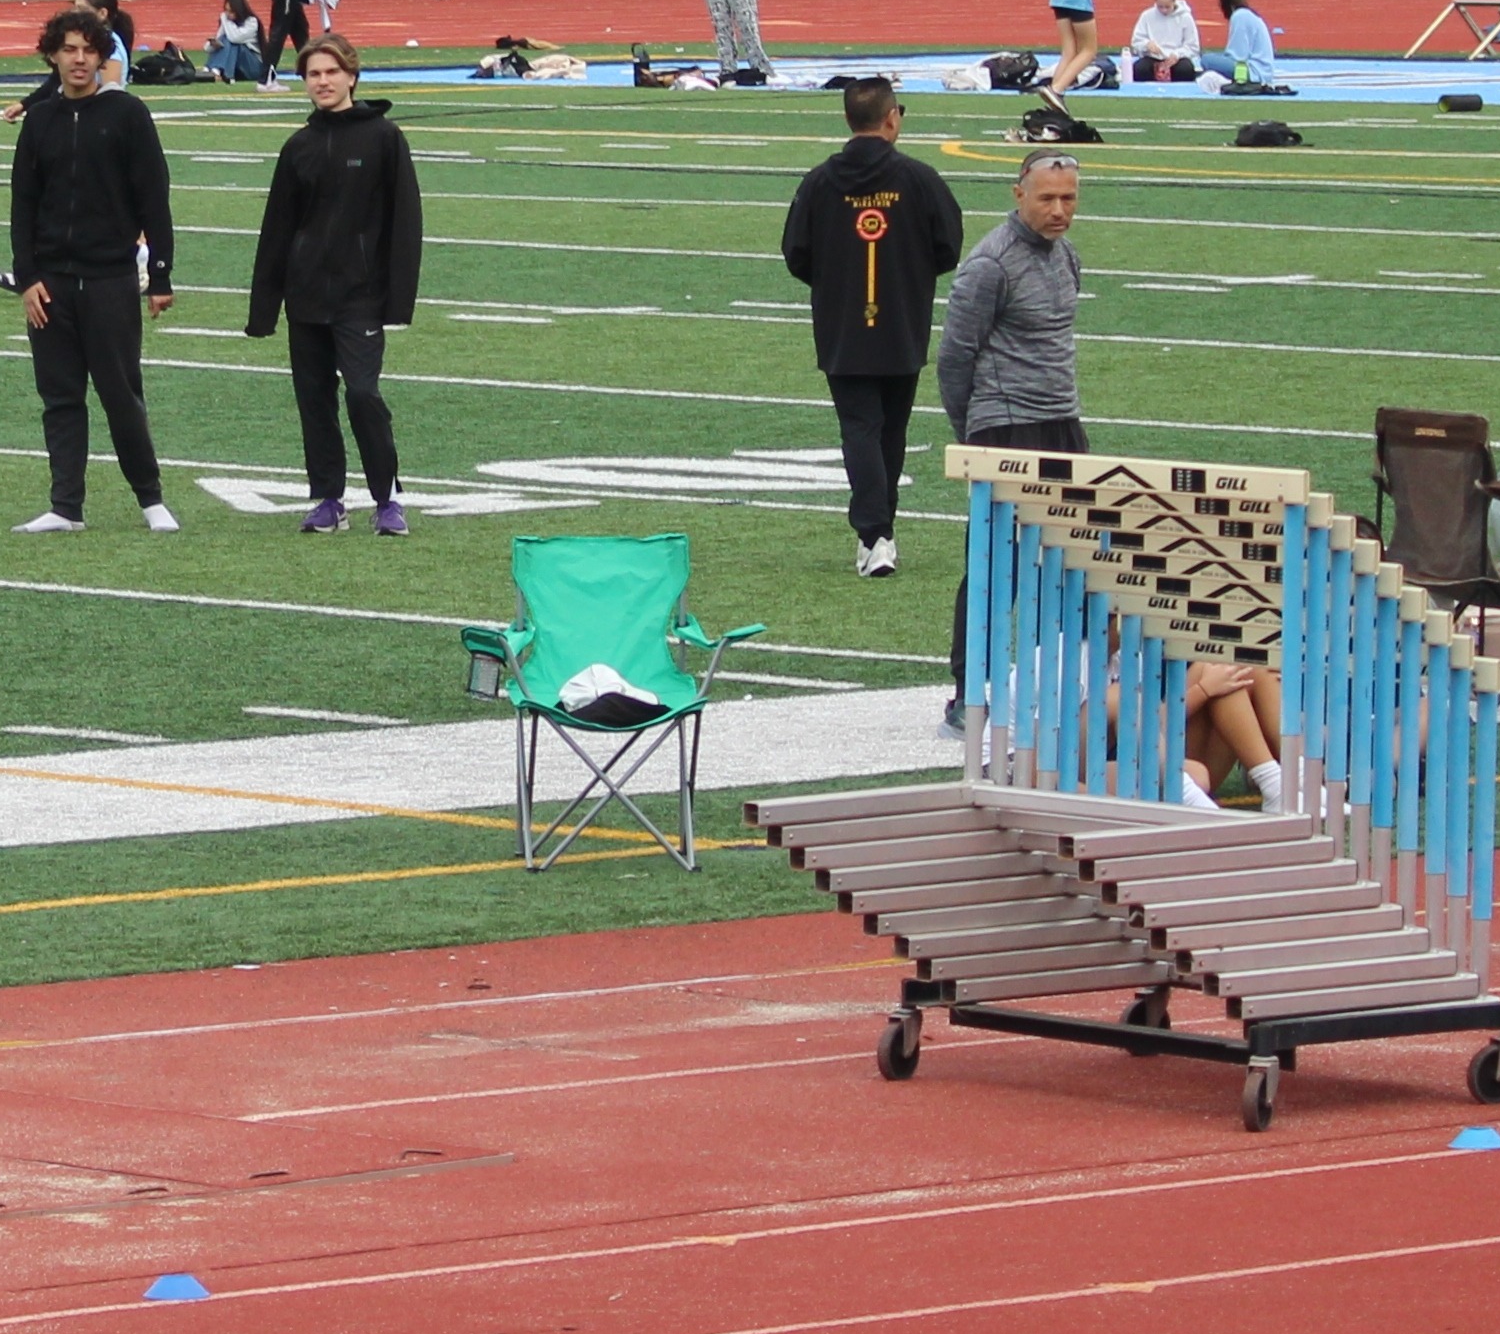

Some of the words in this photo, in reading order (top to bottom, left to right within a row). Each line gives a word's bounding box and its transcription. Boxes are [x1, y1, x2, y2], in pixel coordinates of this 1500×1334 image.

[999, 459, 1029, 474] GILL
[1021, 484, 1052, 495] GILL
[1216, 477, 1248, 491] GILL
[1048, 506, 1078, 518] GILL
[1239, 501, 1271, 514] GILL
[1070, 528, 1100, 540] GILL
[1092, 551, 1123, 563] GILL
[1116, 573, 1147, 586] GILL
[1148, 597, 1178, 610] GILL
[1169, 619, 1200, 632] GILL
[1194, 643, 1225, 655] GILL
